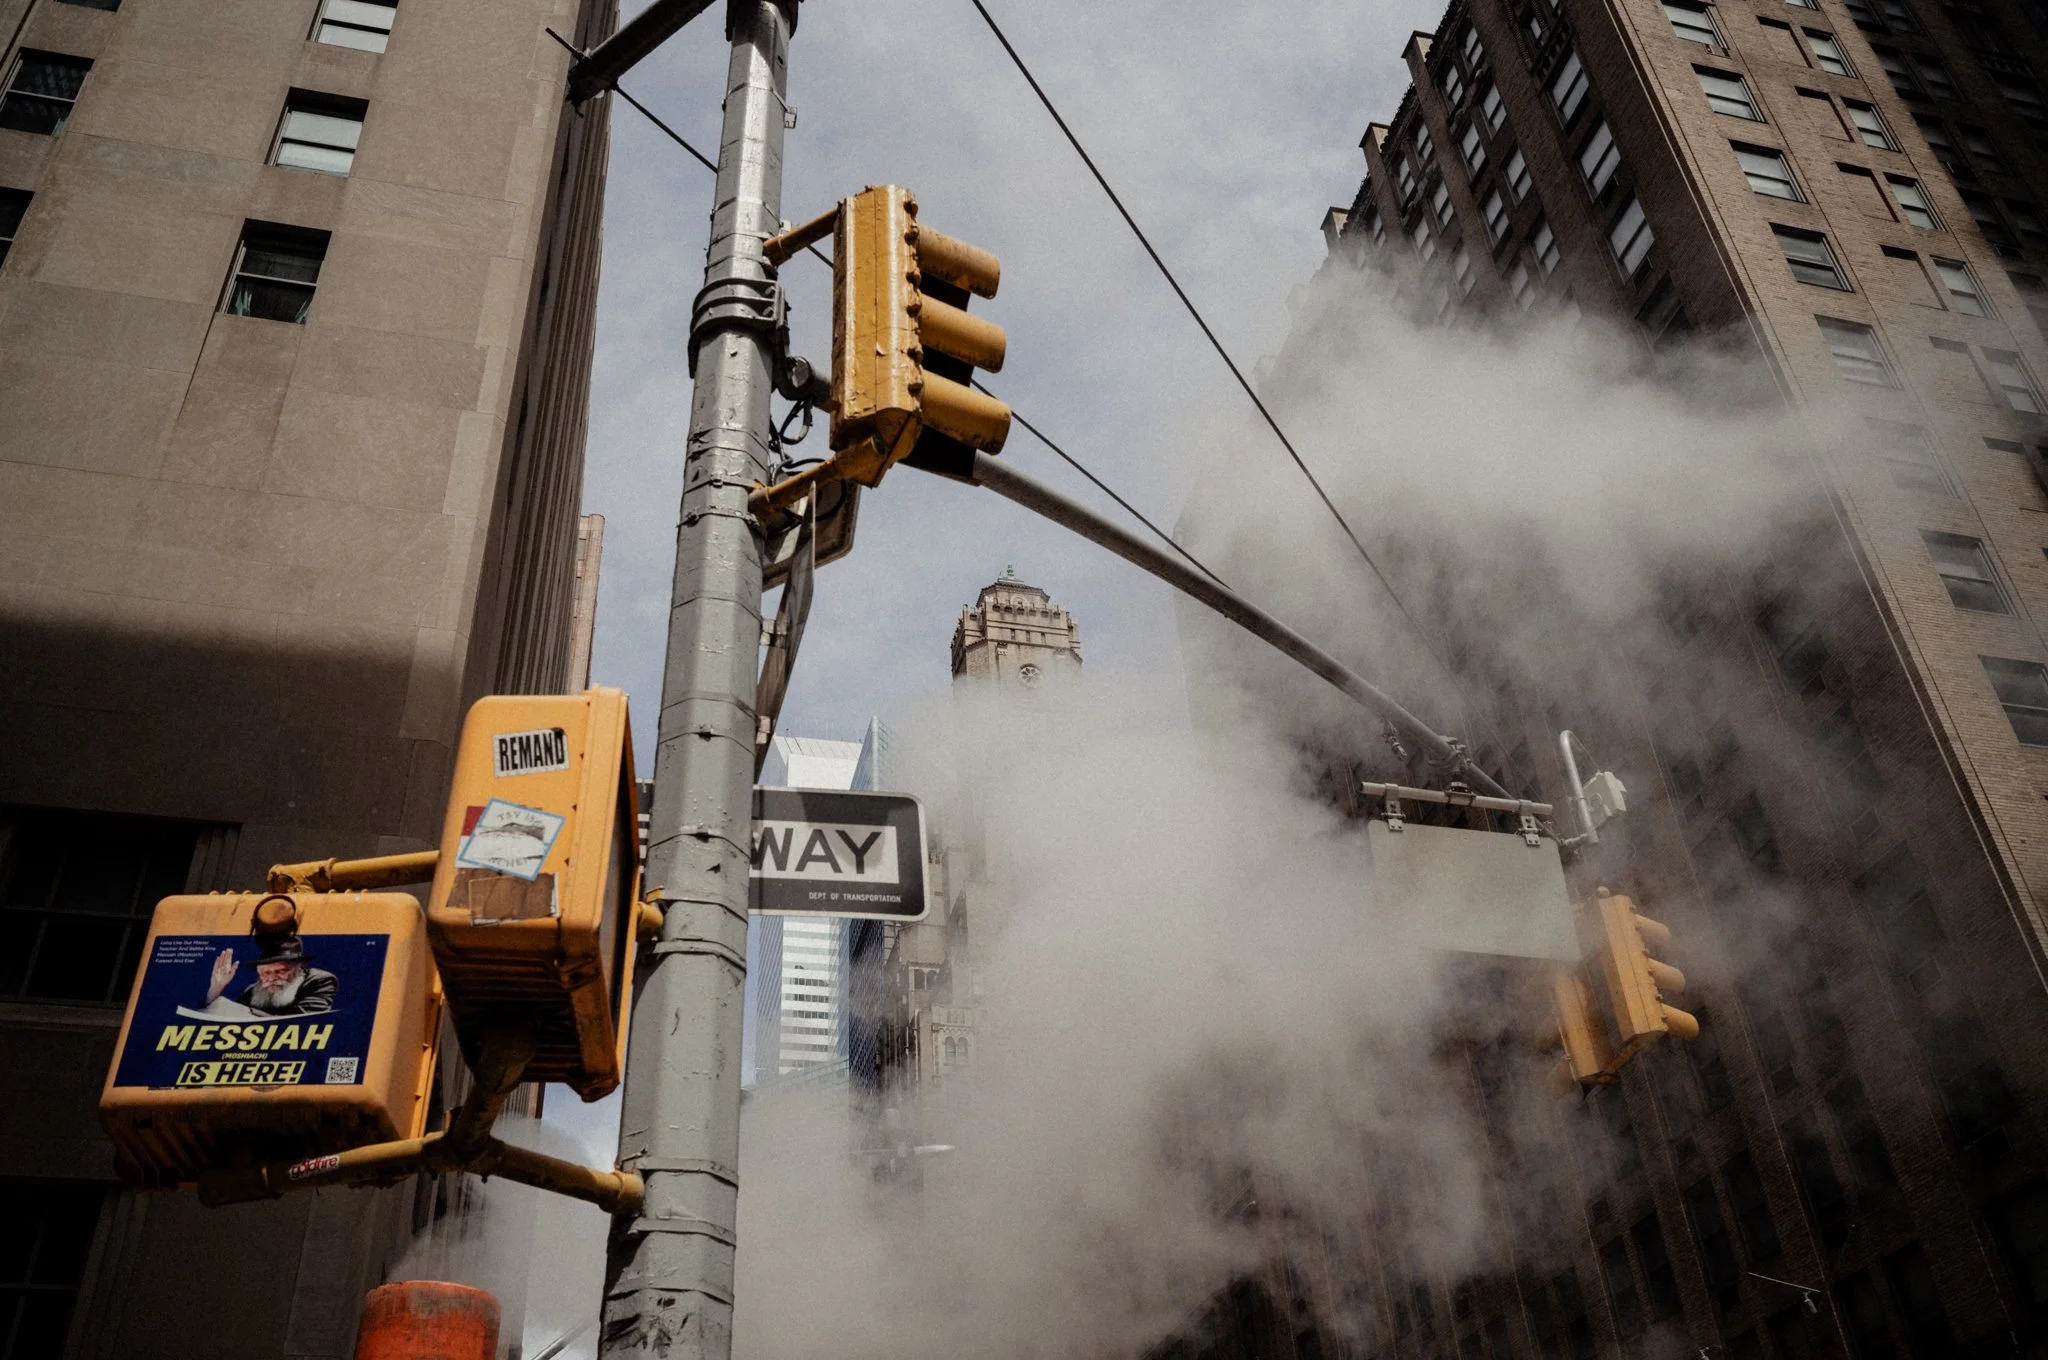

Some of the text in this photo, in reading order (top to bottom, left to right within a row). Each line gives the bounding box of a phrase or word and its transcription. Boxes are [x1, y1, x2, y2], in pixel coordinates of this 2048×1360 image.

[498, 732, 565, 772] REMAND
[749, 826, 883, 875] WAY
[830, 892, 839, 900] OF
[843, 893, 901, 903] TRANSPORTATION
[155, 1024, 334, 1051] MESSIAH
[180, 1063, 303, 1083] IS HERE!
